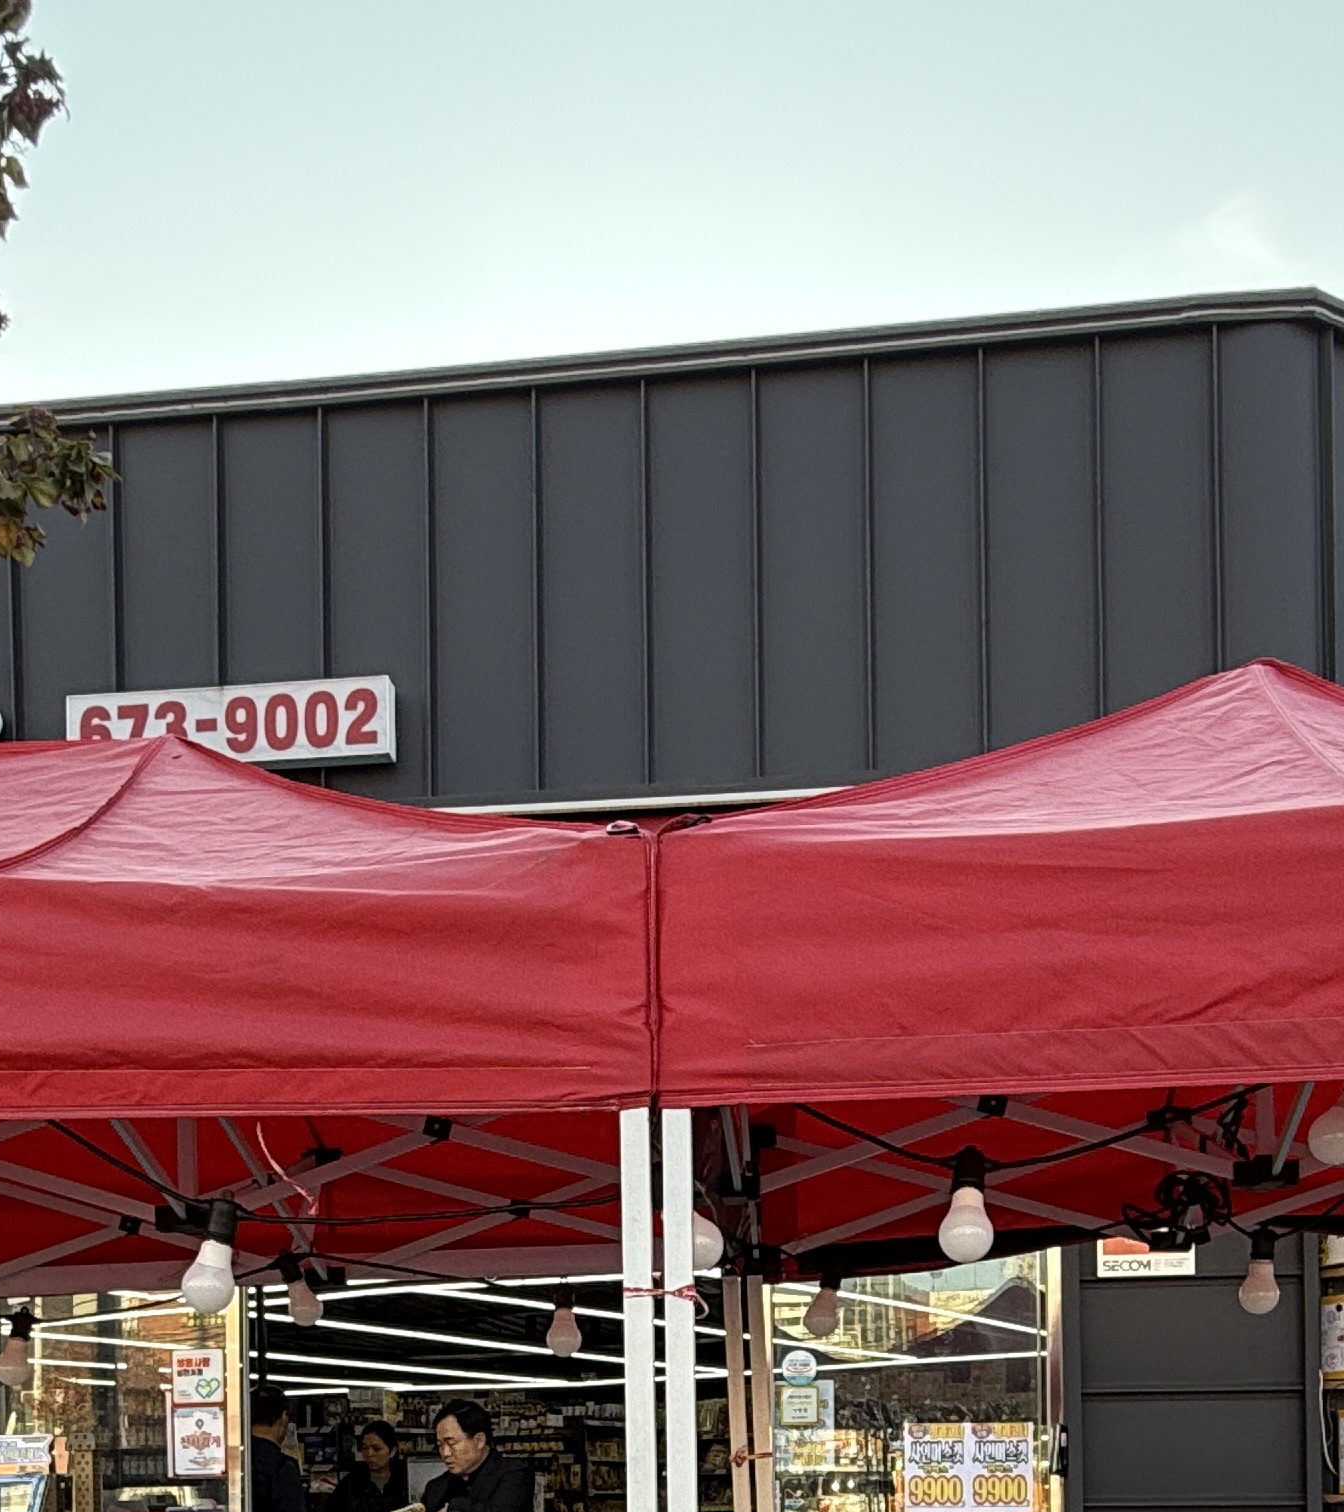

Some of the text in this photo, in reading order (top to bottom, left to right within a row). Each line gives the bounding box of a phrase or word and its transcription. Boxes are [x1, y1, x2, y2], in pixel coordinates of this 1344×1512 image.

[80, 688, 379, 754] 673-9002
[1103, 1259, 1151, 1271] SECOM
[909, 1475, 963, 1506] 9900
[972, 1474, 1027, 1505] 9900
